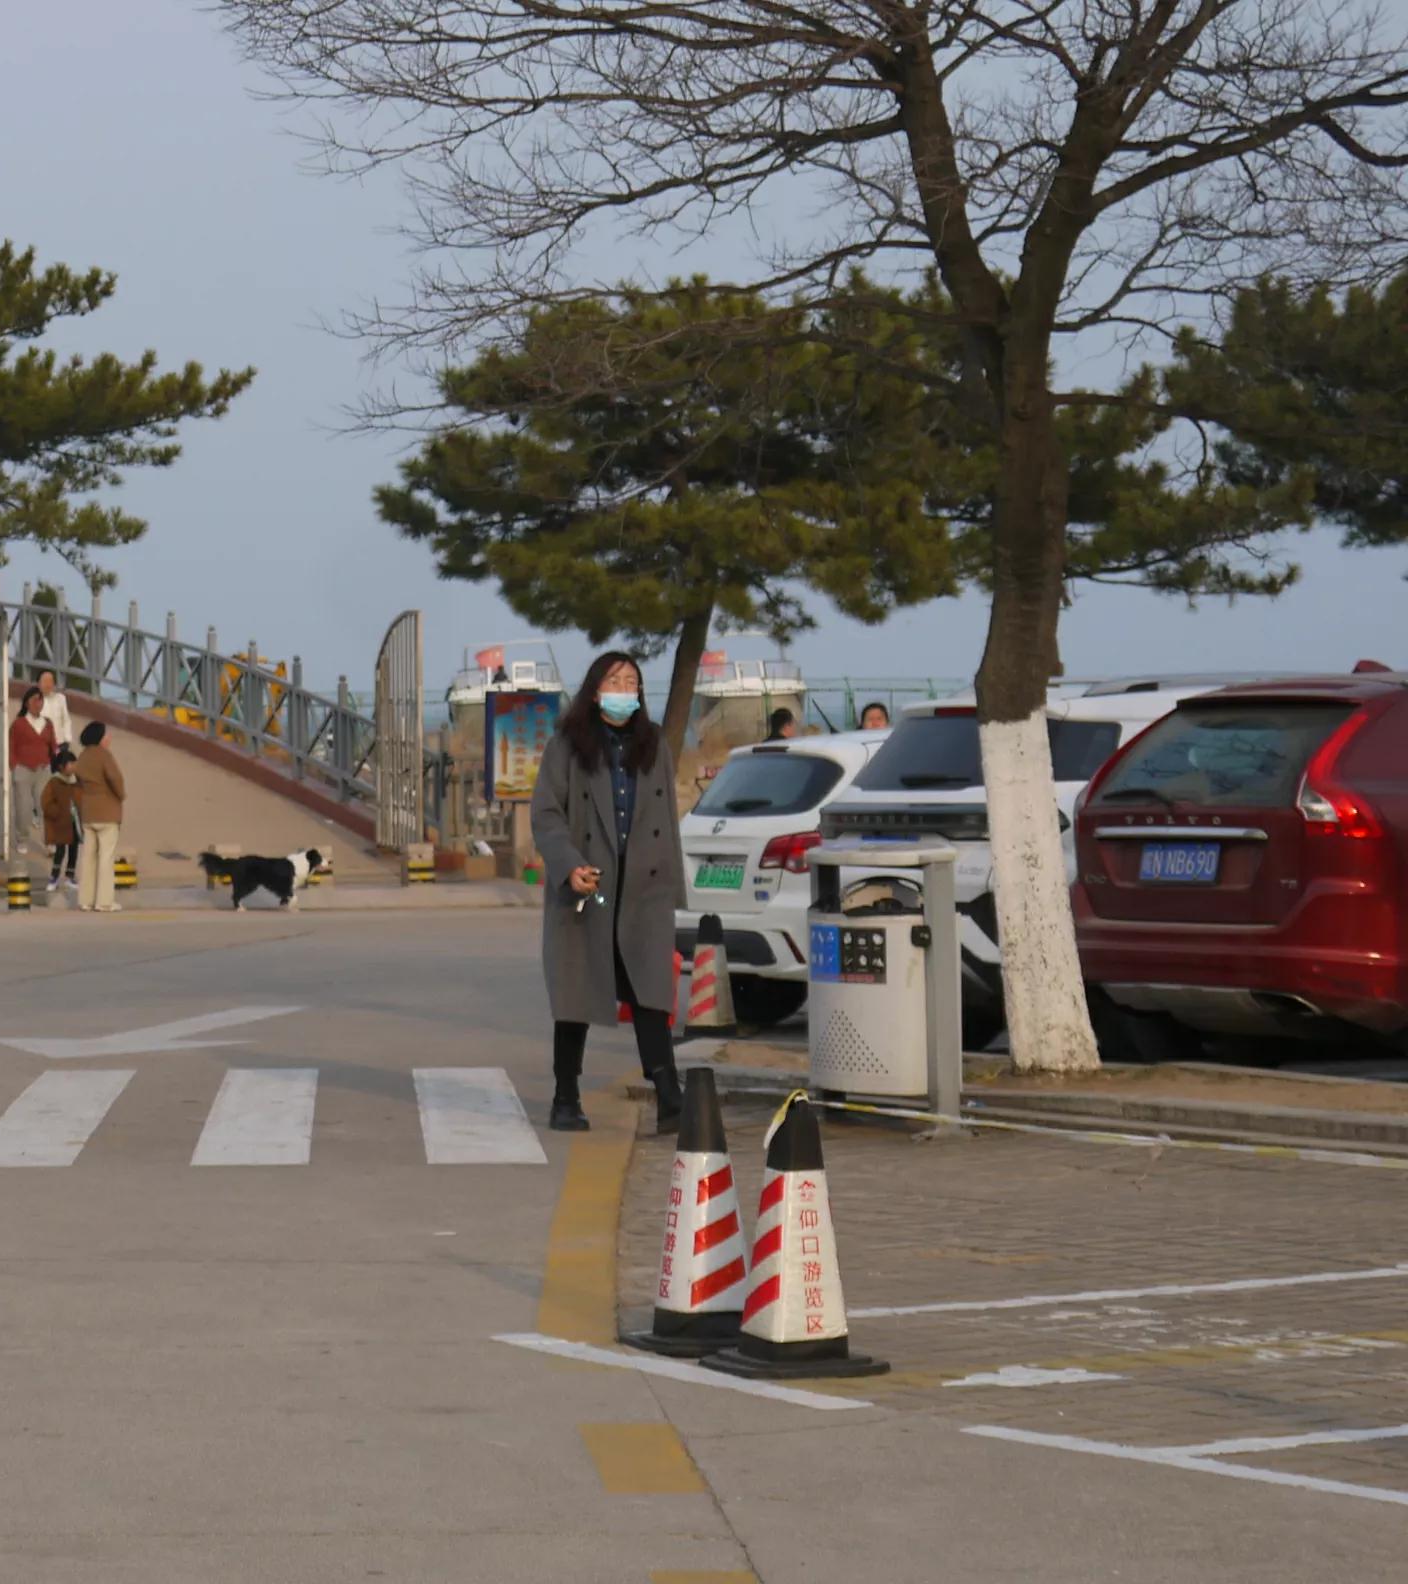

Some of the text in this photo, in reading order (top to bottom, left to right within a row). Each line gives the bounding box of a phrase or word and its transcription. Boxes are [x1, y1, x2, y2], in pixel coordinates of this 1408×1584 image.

[1125, 815, 1222, 825] VOLVO
[799, 1209, 823, 1334] 仰口游览区
